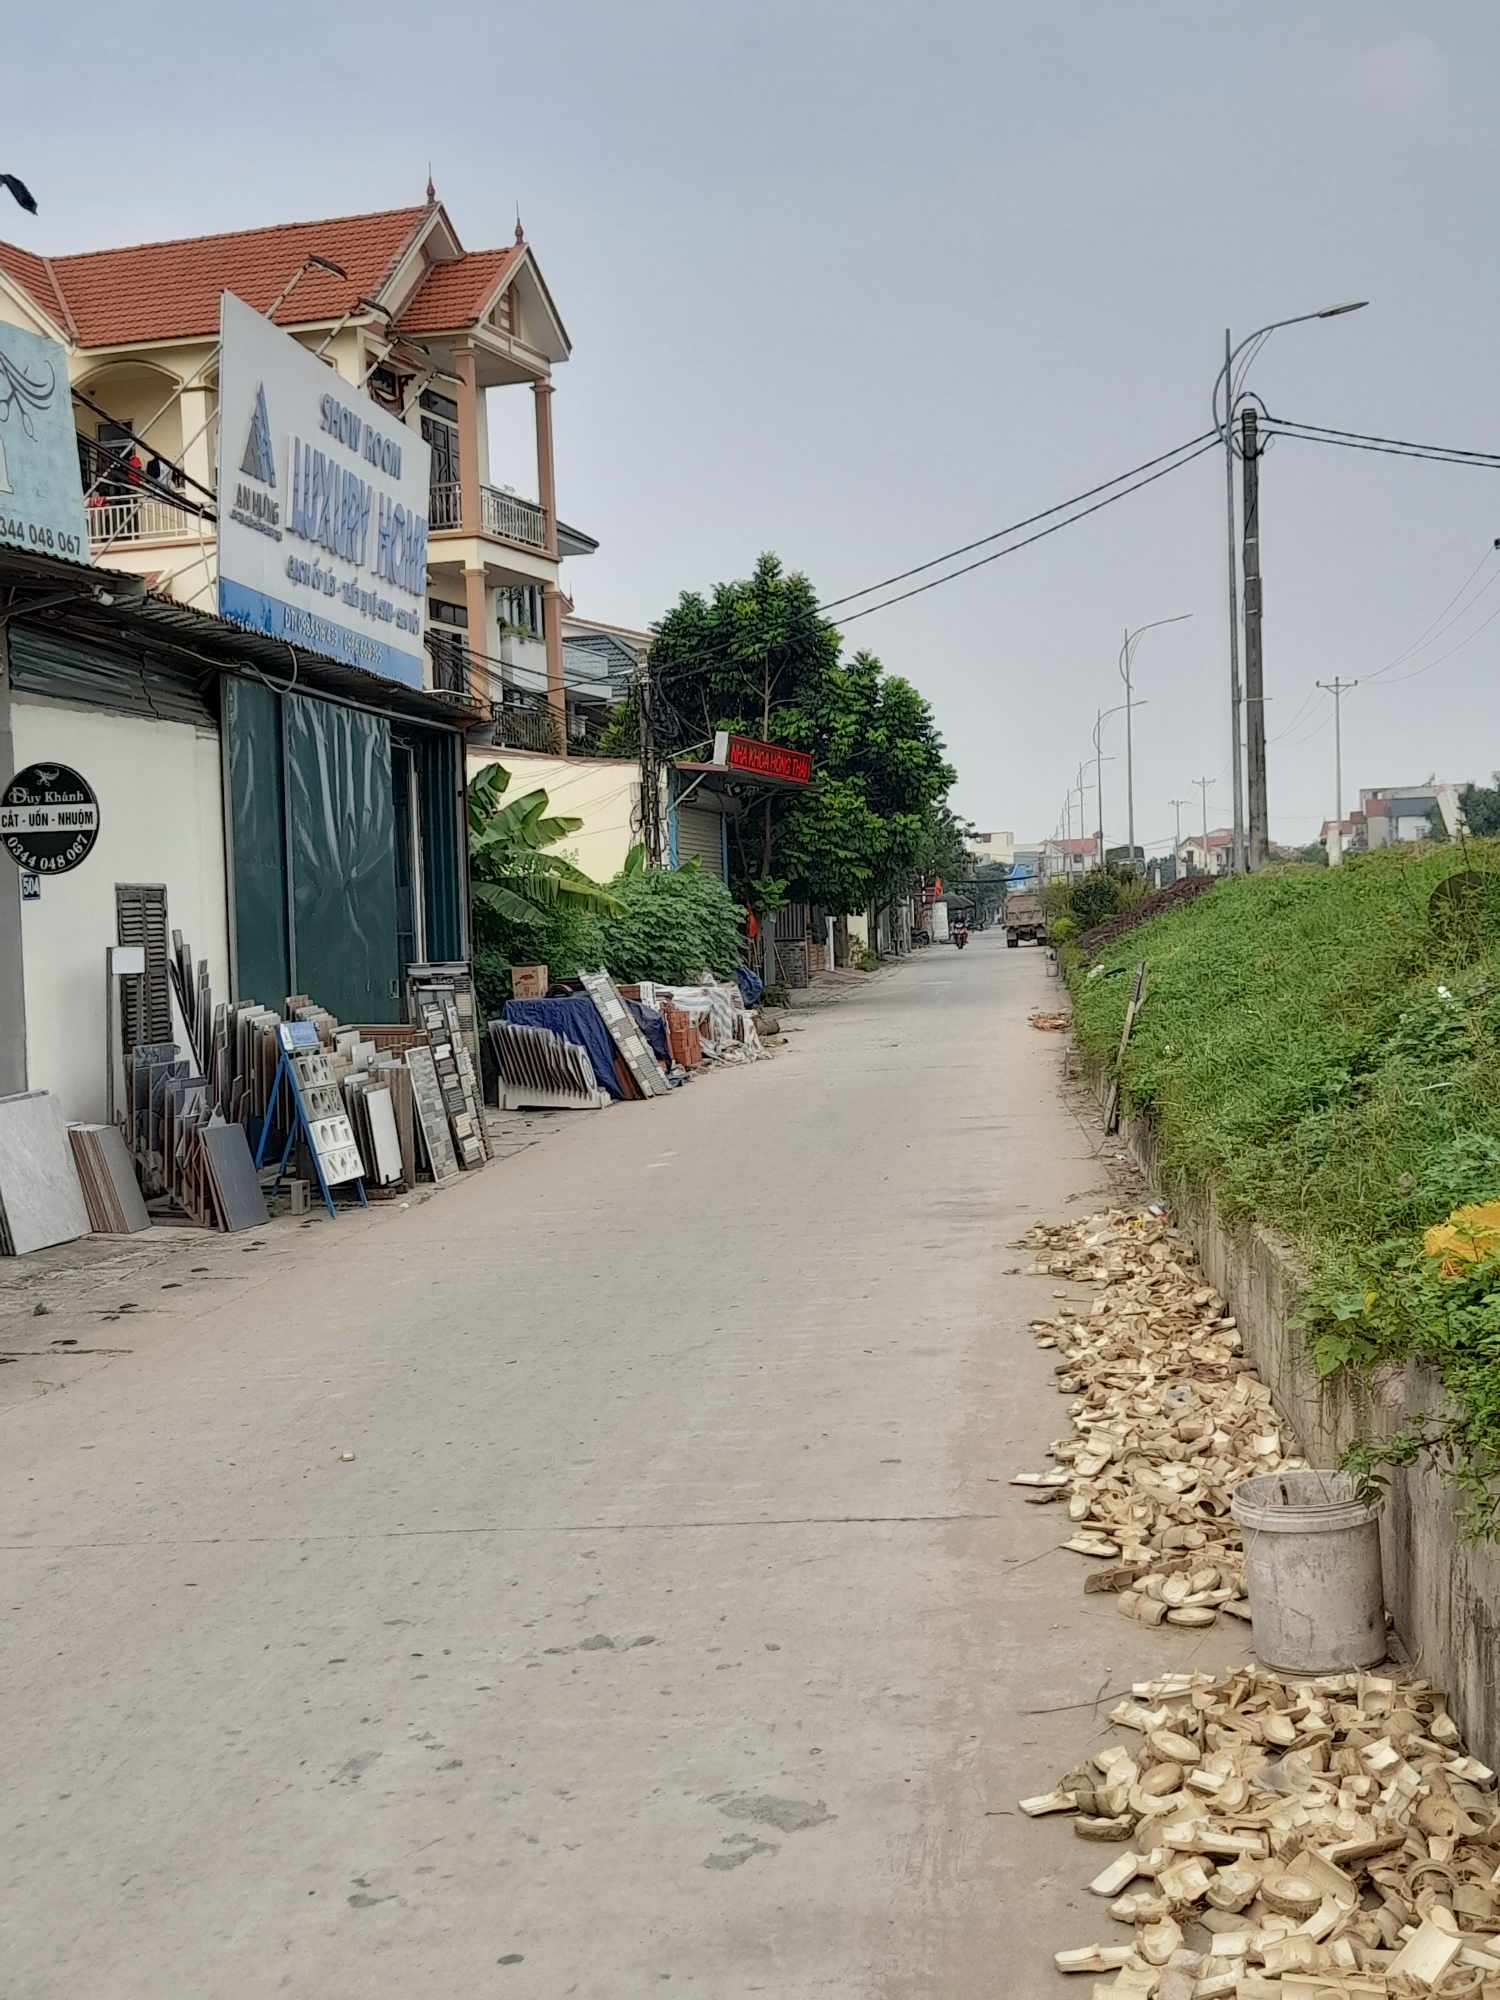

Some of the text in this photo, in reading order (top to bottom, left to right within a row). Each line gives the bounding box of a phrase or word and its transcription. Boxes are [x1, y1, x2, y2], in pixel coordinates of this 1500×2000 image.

[320, 392, 362, 452] SHOW
[287, 435, 372, 566] LUXURY
[29, 523, 54, 549] 048
[58, 531, 80, 556] 067
[748, 749, 769, 769] KHOA
[44, 790, 84, 803] Khánh
[28, 808, 48, 827] UỐN
[58, 808, 93, 828] NHUỘM
[7, 834, 88, 870] 0344 048 067
